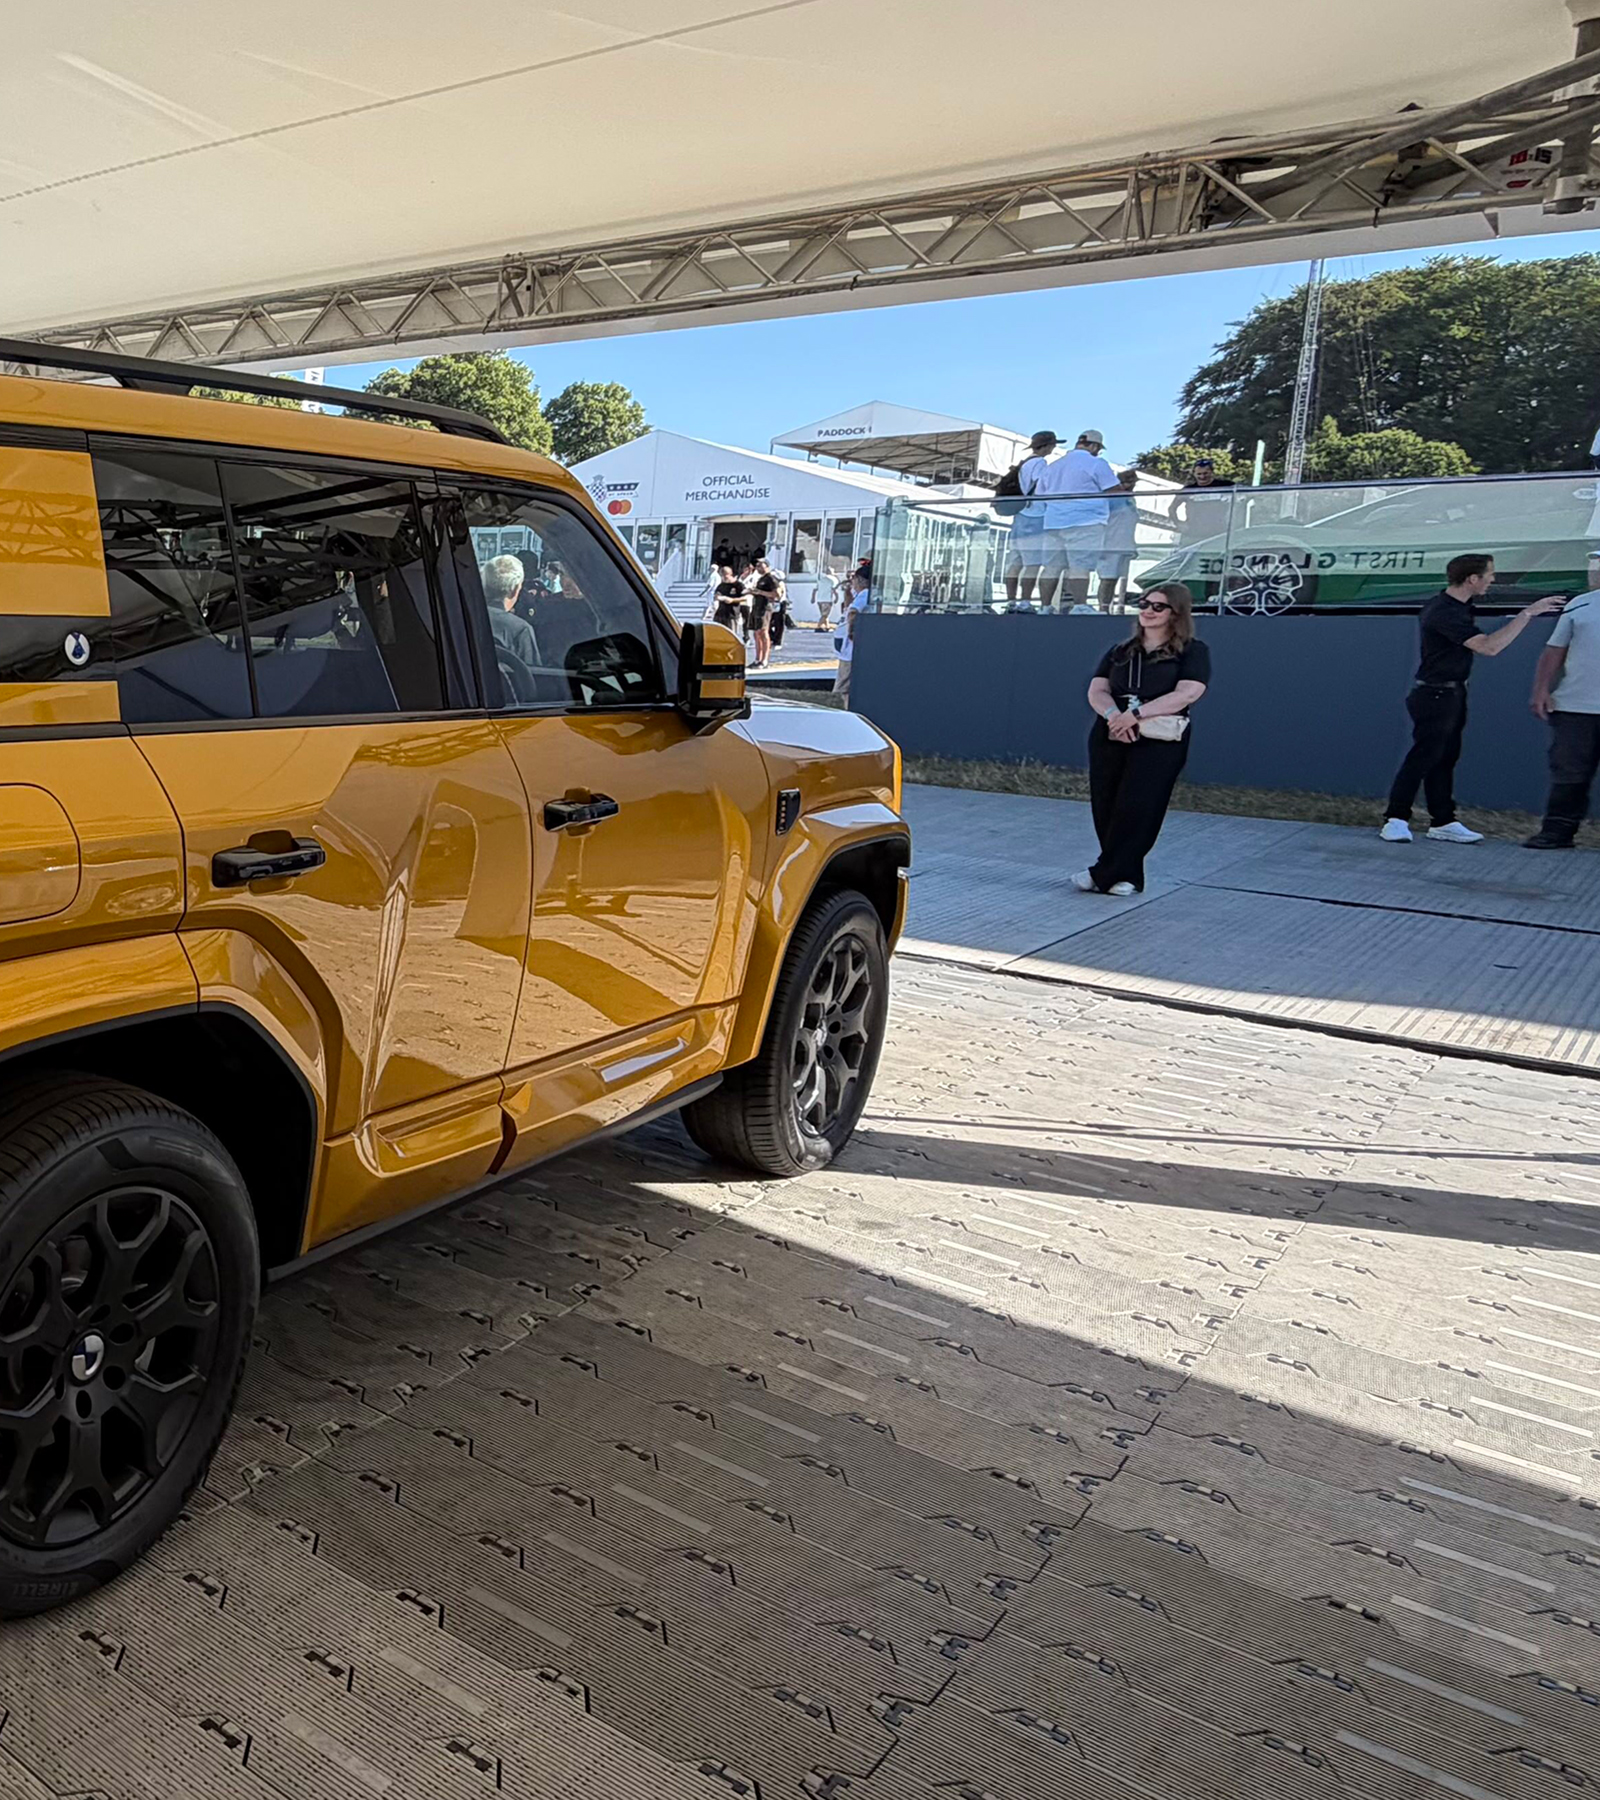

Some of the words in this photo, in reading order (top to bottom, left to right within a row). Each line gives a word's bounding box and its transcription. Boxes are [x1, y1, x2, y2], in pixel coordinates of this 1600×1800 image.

[817, 427, 866, 437] PADDOCK
[702, 474, 755, 487] OFFICIAL
[685, 487, 770, 501] MERCHANDISE
